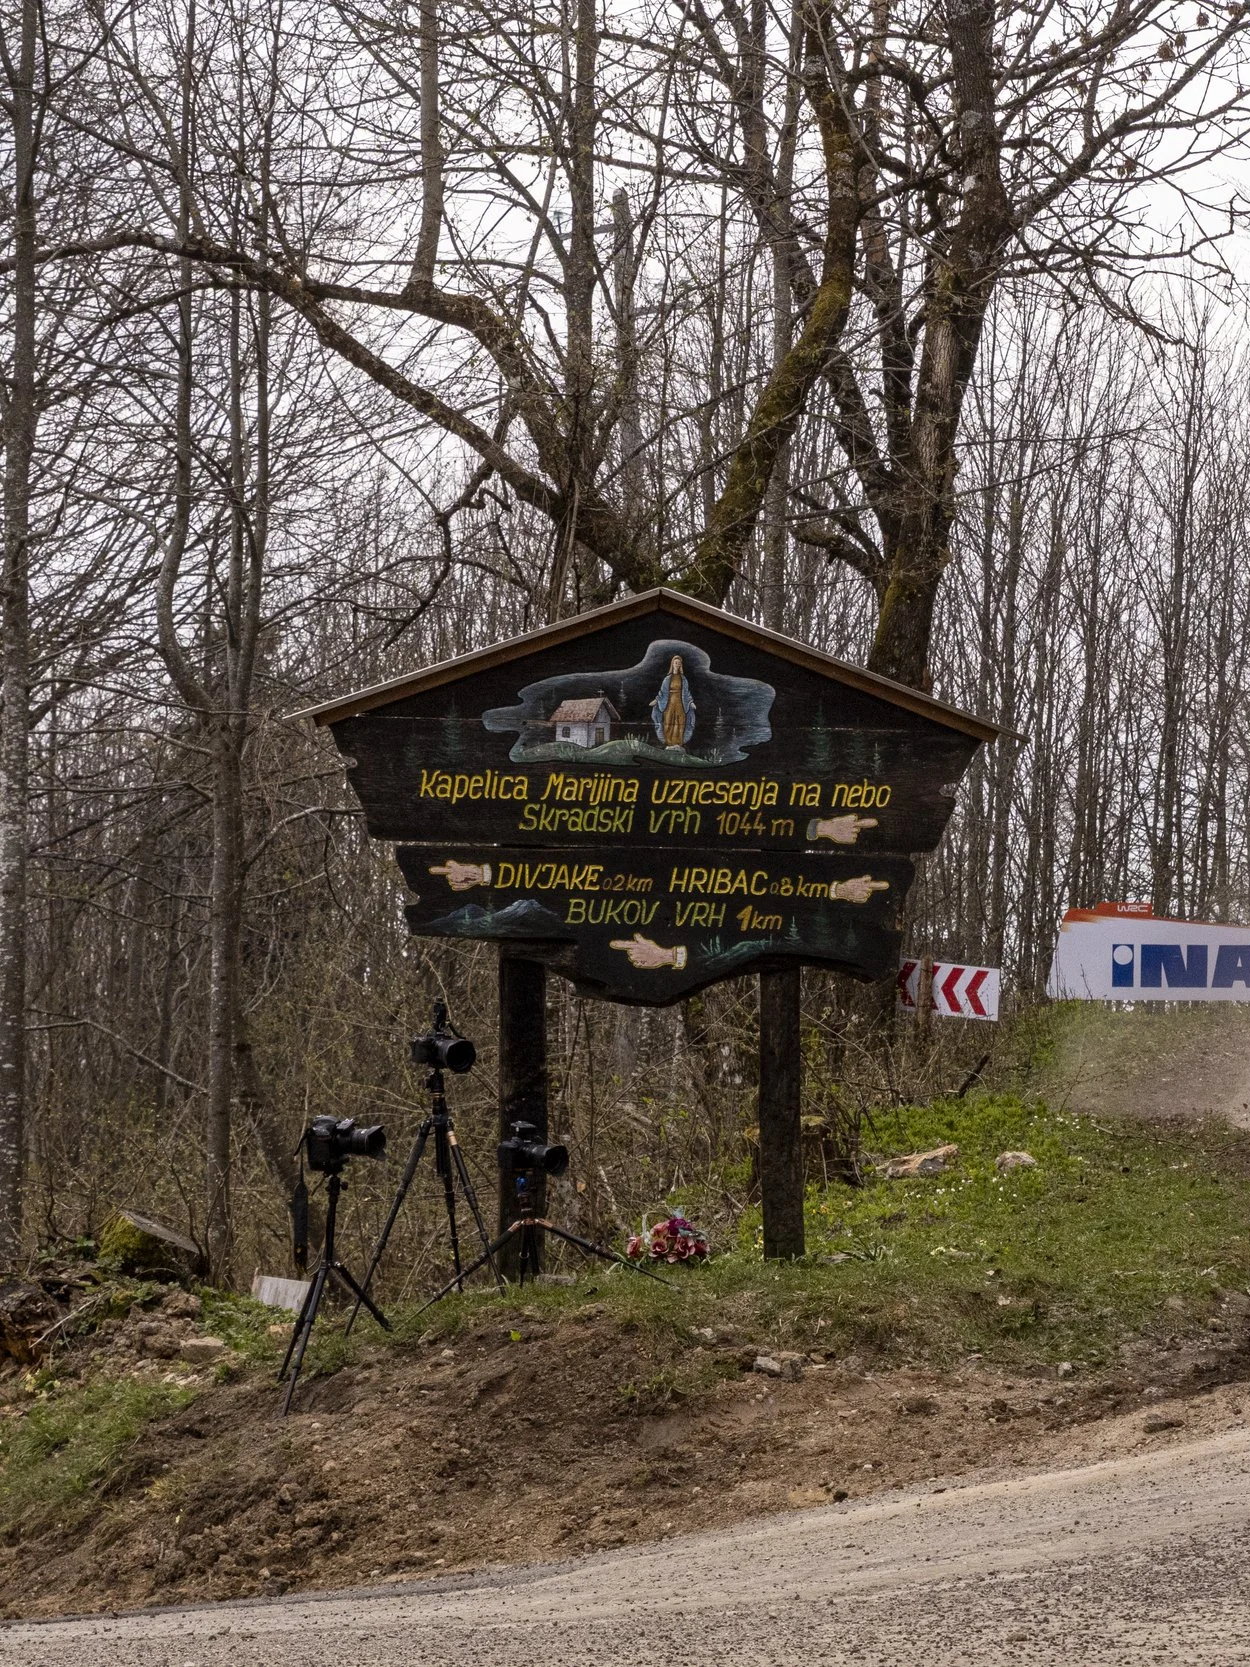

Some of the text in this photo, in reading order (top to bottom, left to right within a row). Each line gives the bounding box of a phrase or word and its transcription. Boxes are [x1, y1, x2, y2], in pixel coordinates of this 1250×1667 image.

[419, 768, 891, 810] Kapelica Marijina uznesenja na nebo
[518, 803, 636, 833] Skradski
[716, 811, 766, 835] 1044
[771, 819, 795, 836] m
[494, 862, 603, 891] DIVJAKE
[669, 866, 768, 896] HRIBAC
[565, 898, 660, 925] BUKOV
[675, 901, 727, 928] VRH
[1117, 904, 1149, 913] WRC
